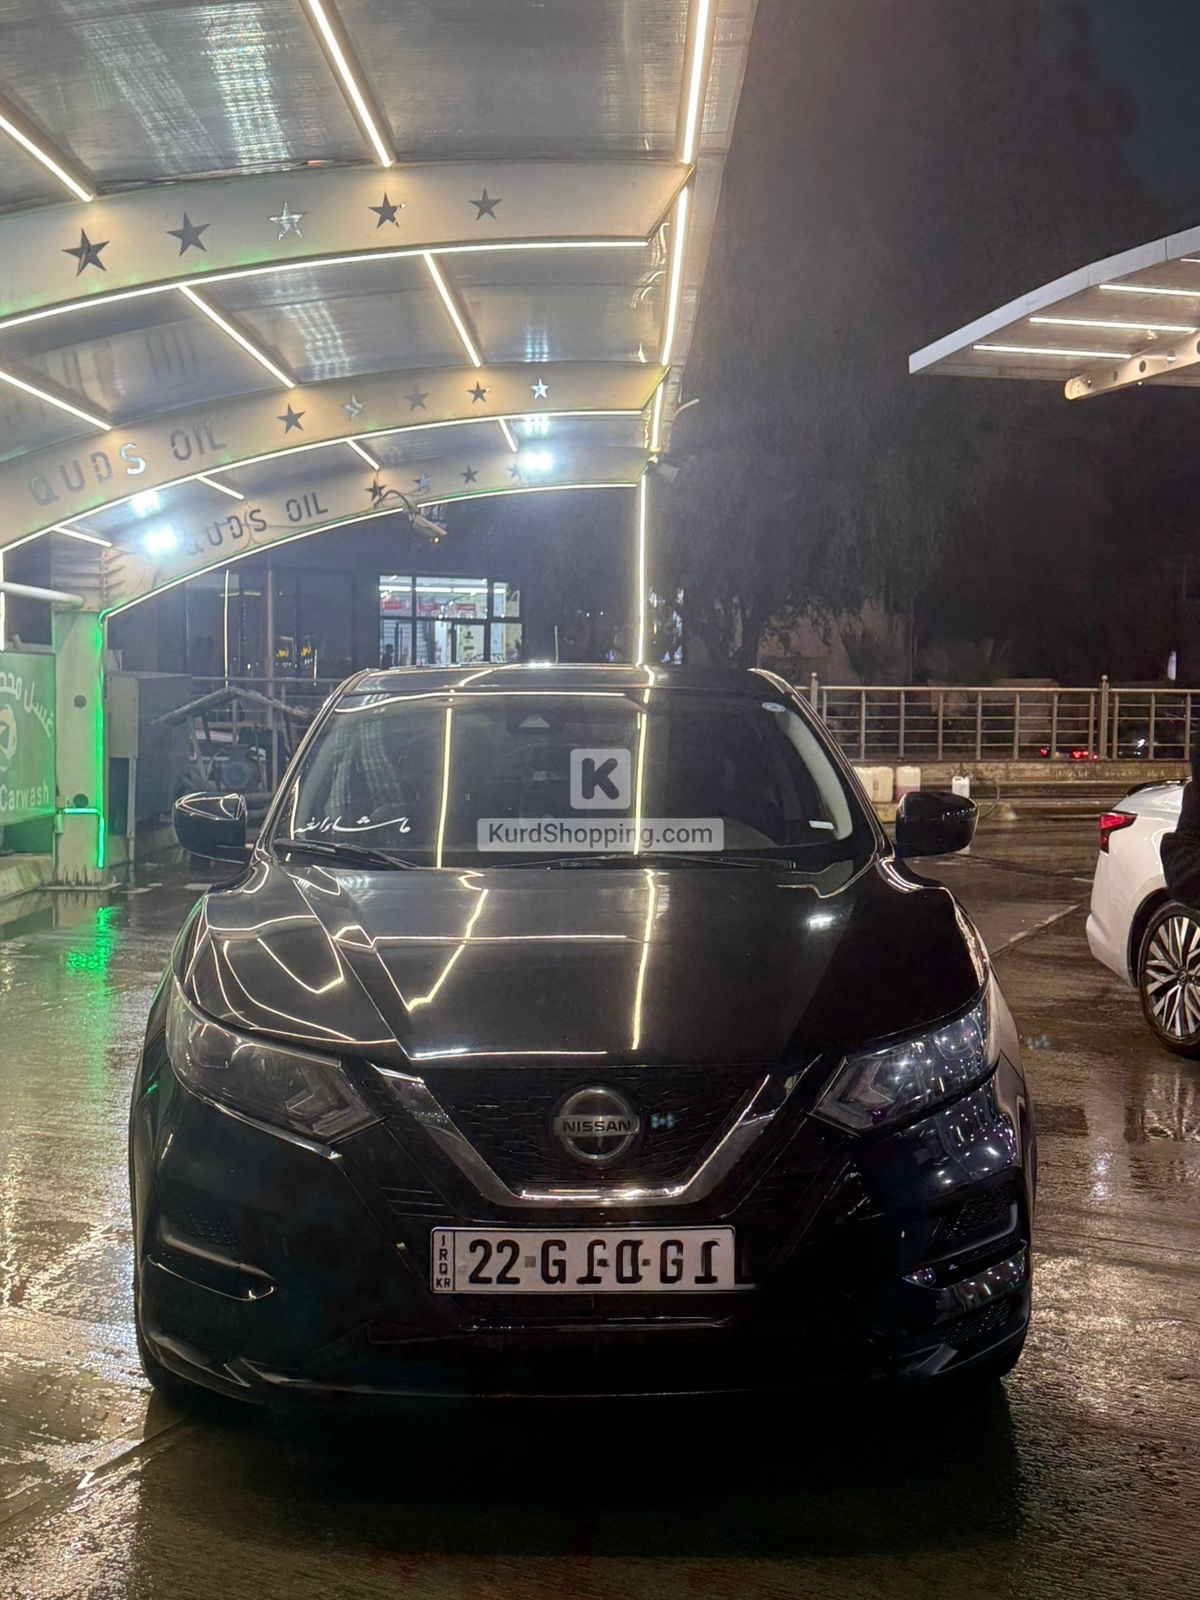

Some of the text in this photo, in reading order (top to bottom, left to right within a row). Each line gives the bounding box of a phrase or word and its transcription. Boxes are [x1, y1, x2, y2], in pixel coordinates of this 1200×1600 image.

[28, 421, 226, 505] QUDS OIL
[286, 492, 328, 522] OIL
[0, 779, 49, 812] Carwash
[563, 1120, 631, 1132] NISSAN
